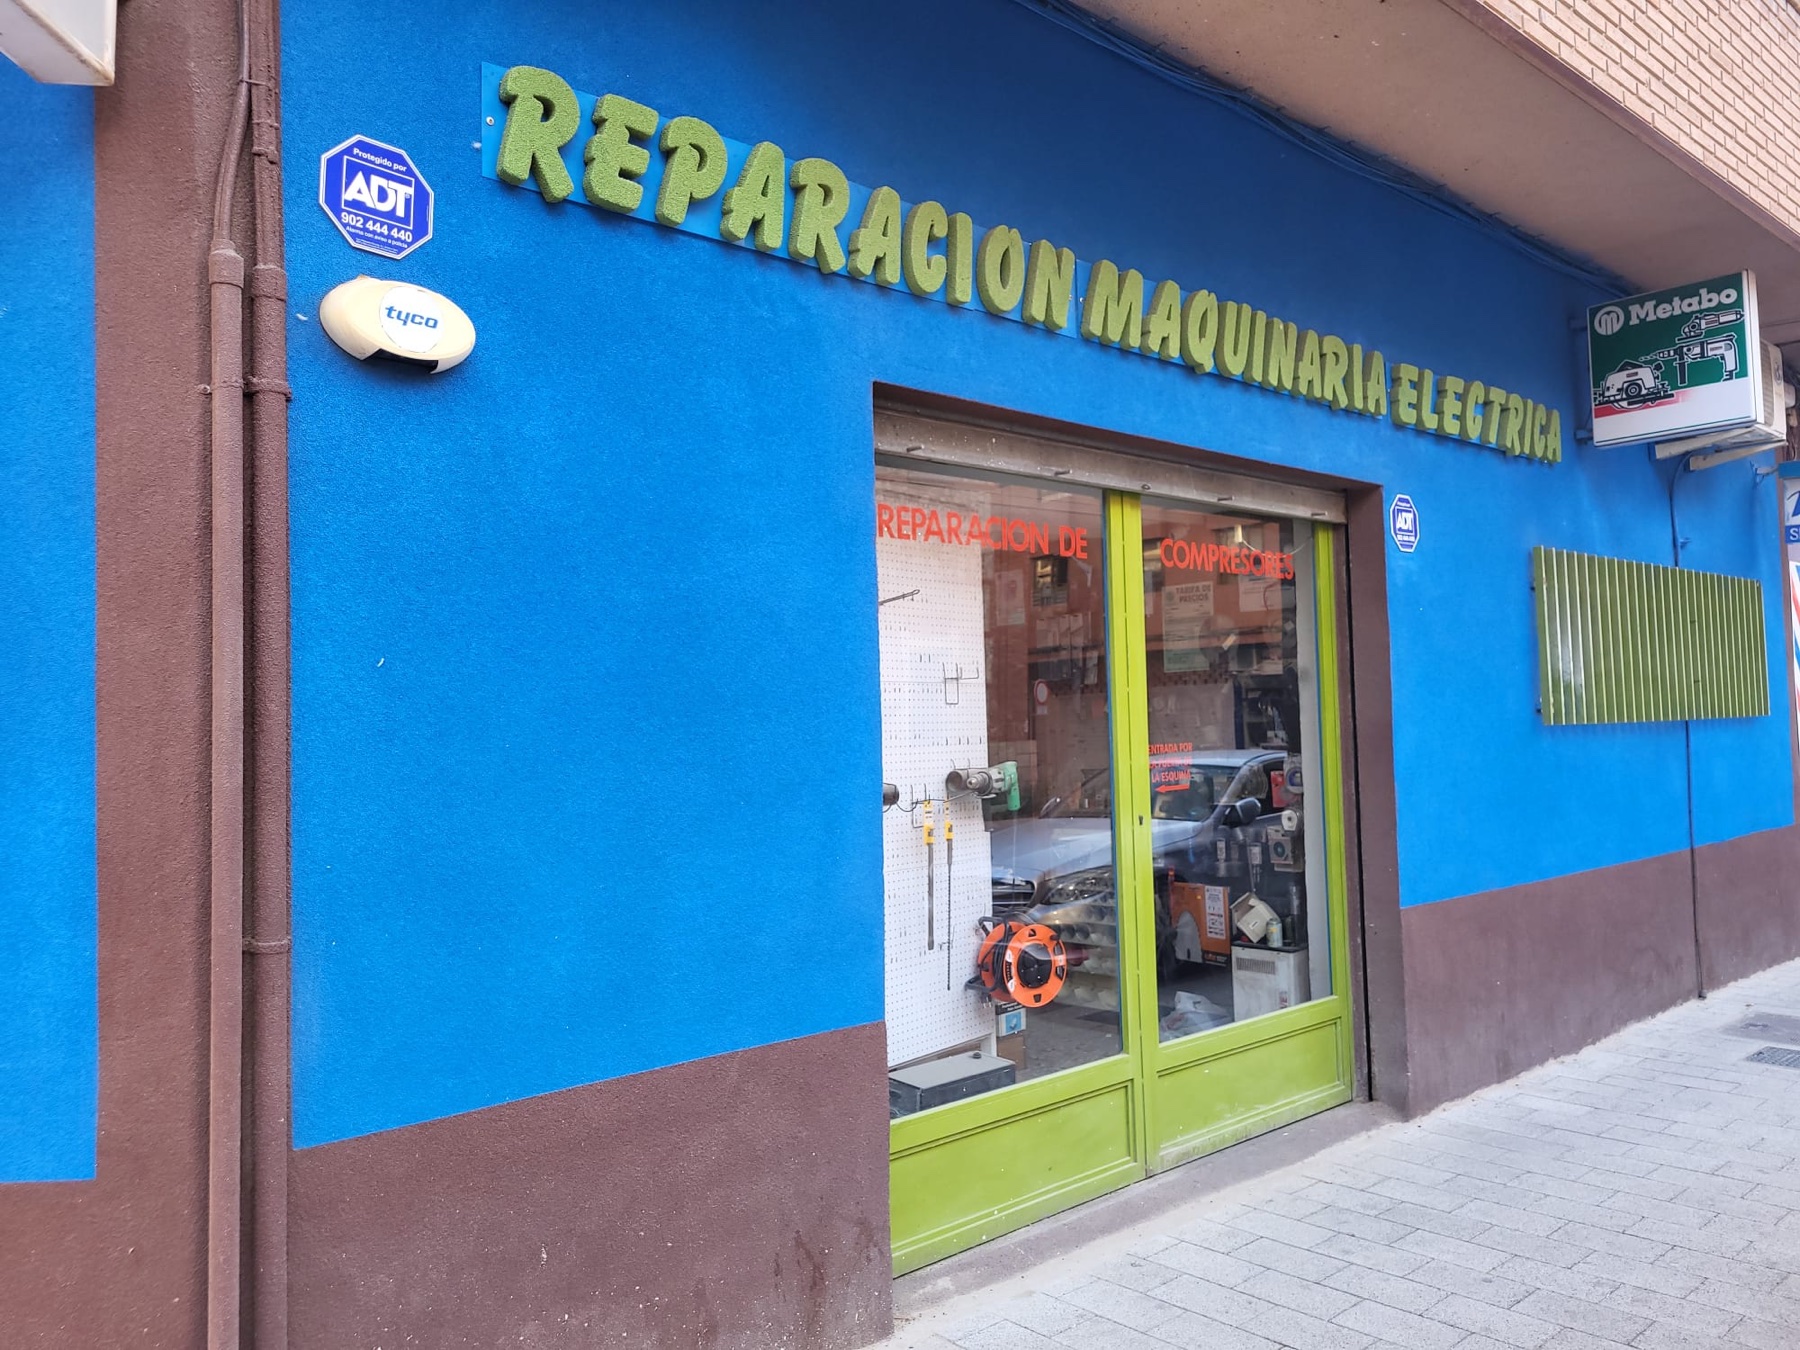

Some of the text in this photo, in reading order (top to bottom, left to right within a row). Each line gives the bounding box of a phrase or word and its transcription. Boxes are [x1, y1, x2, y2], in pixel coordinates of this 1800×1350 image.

[353, 147, 407, 172] Protegido por
[344, 170, 413, 218] ADT
[341, 212, 413, 242] 902 444 440
[496, 65, 1562, 463] REPARACION MAQUINARIA ELECTRICA
[385, 305, 439, 329] tyco
[1628, 288, 1738, 326] Metabo
[877, 503, 1088, 559] REPARACION DE
[1397, 511, 1413, 531] ADT
[1160, 538, 1294, 580] COMPRESORES
[1148, 742, 1193, 755] ENTRADA POR
[1152, 770, 1191, 783] LA ESQUINA
